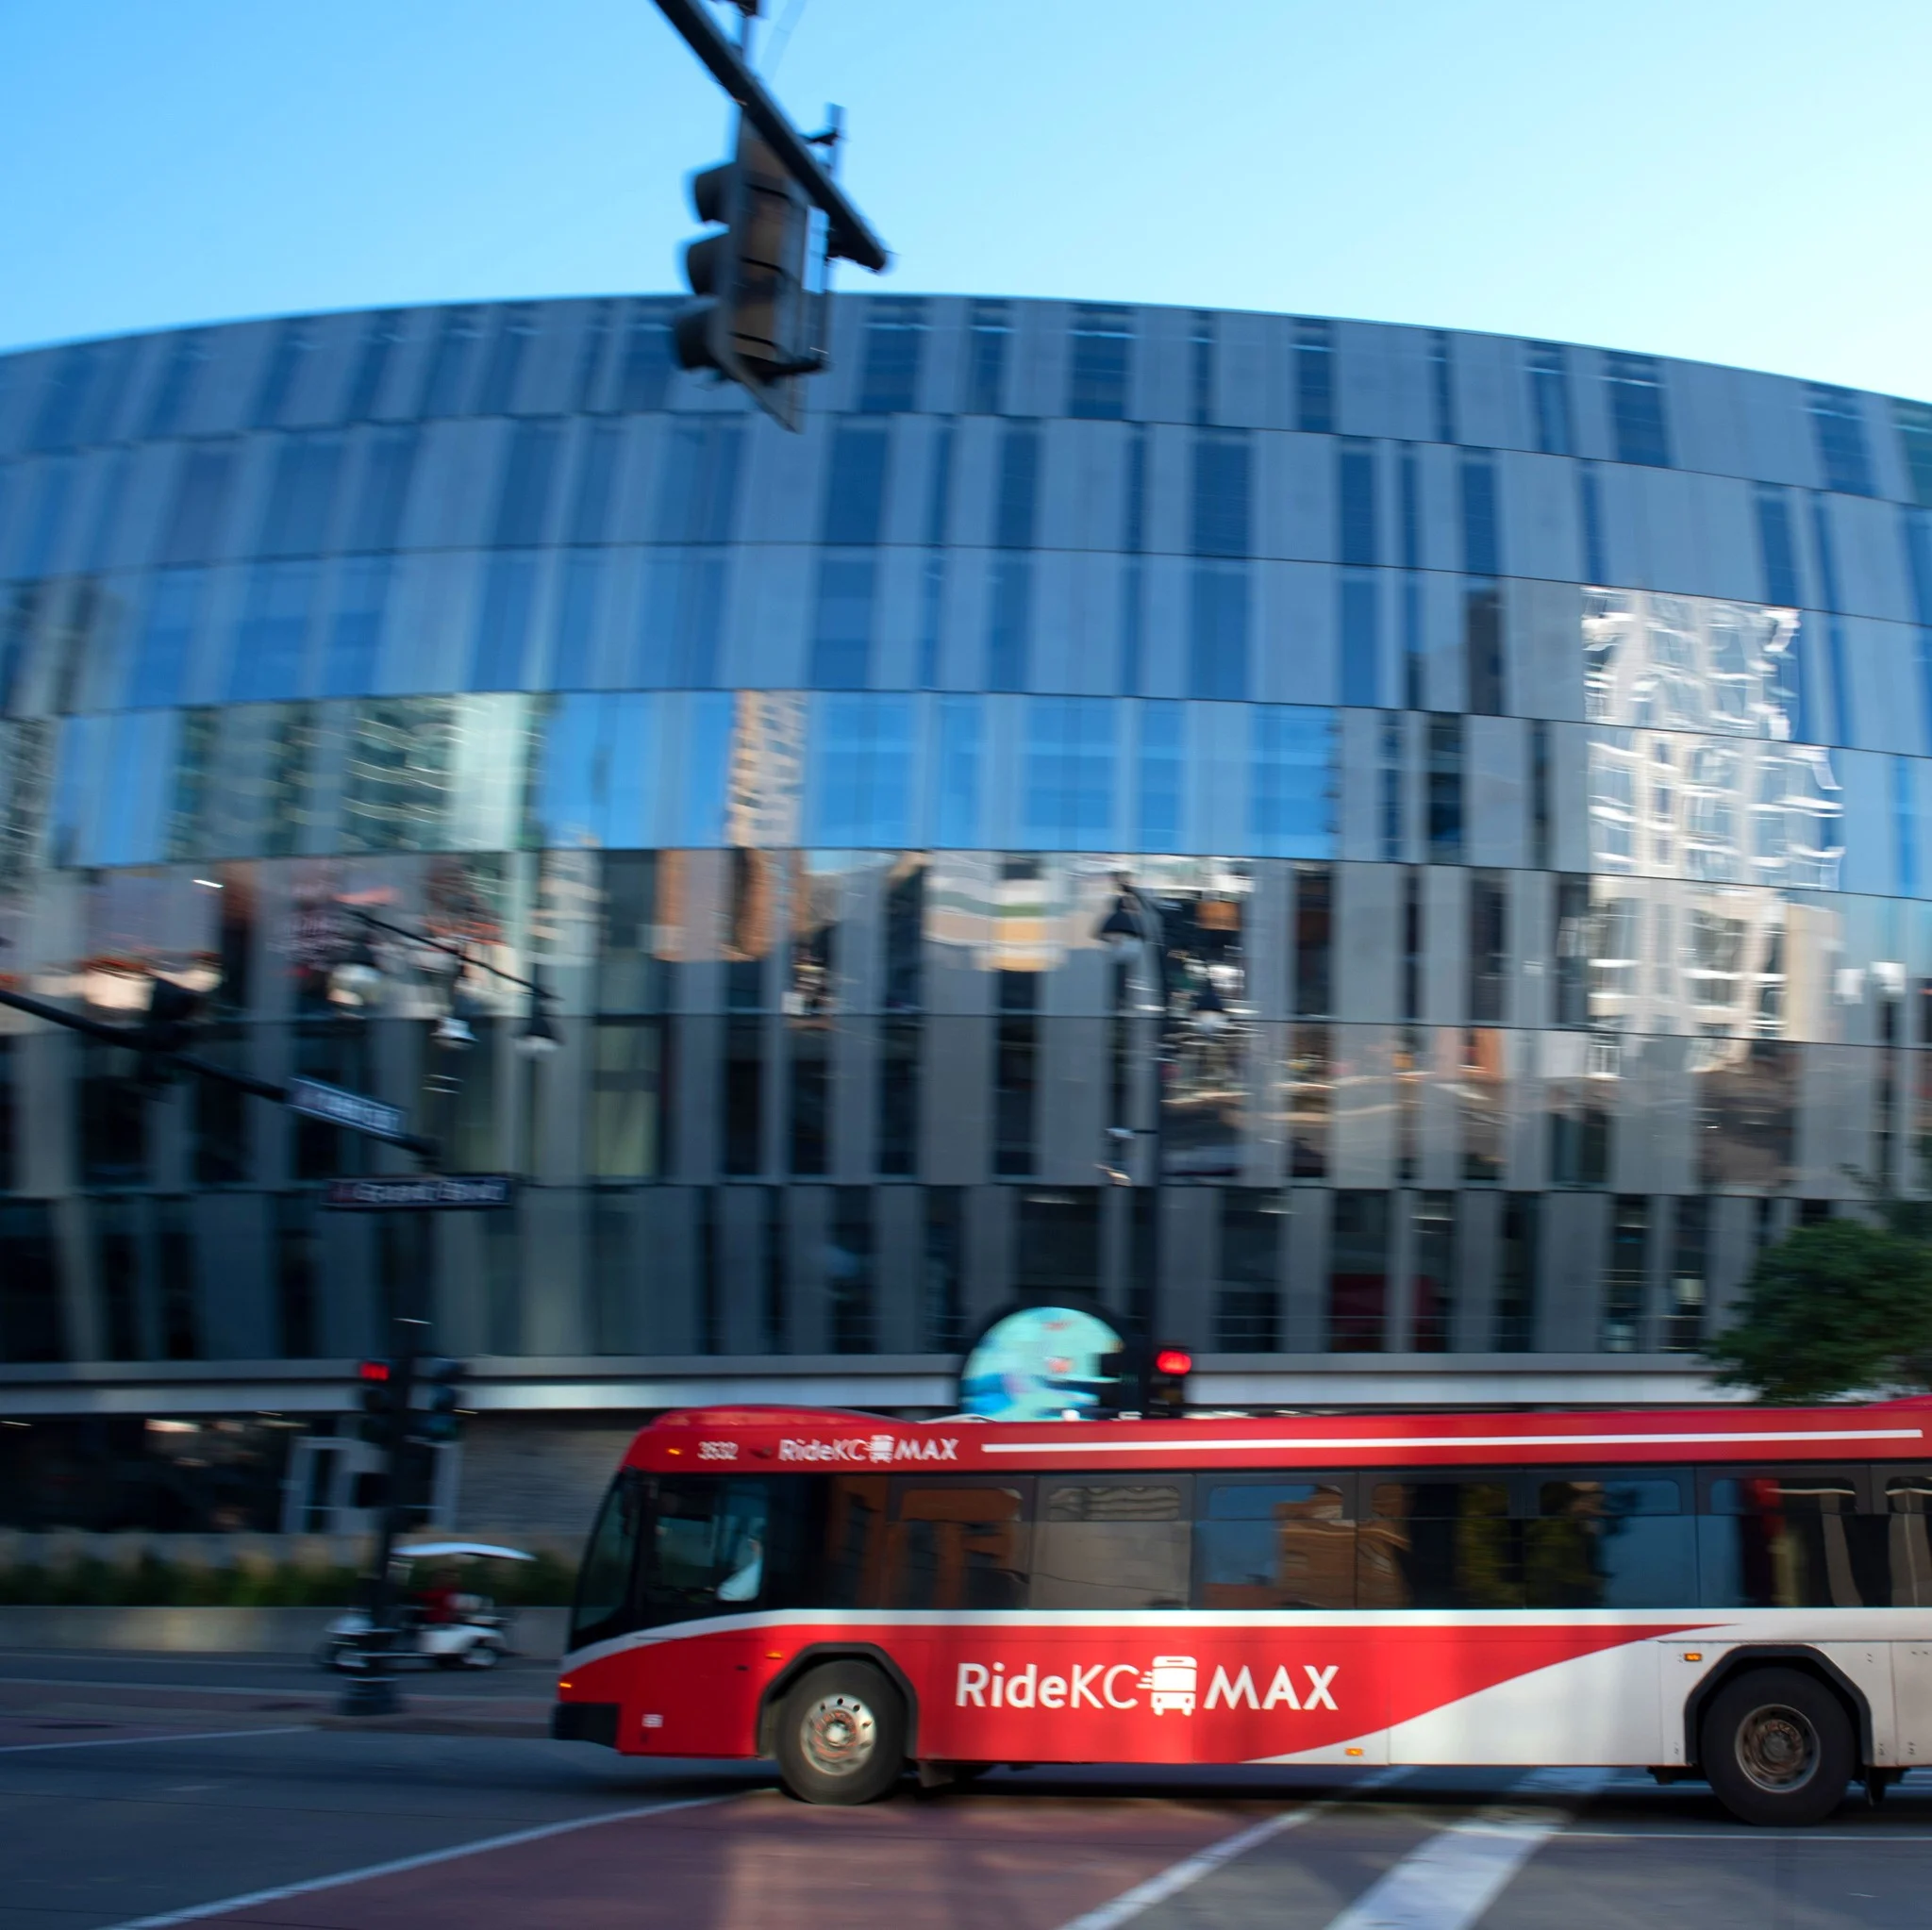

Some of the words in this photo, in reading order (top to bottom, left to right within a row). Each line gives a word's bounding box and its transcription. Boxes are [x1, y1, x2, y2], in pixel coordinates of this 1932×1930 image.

[777, 1438, 867, 1461] RideKC
[896, 1439, 958, 1460] MAX
[955, 1661, 1140, 1709] RideKC
[1203, 1664, 1341, 1711] MAX
